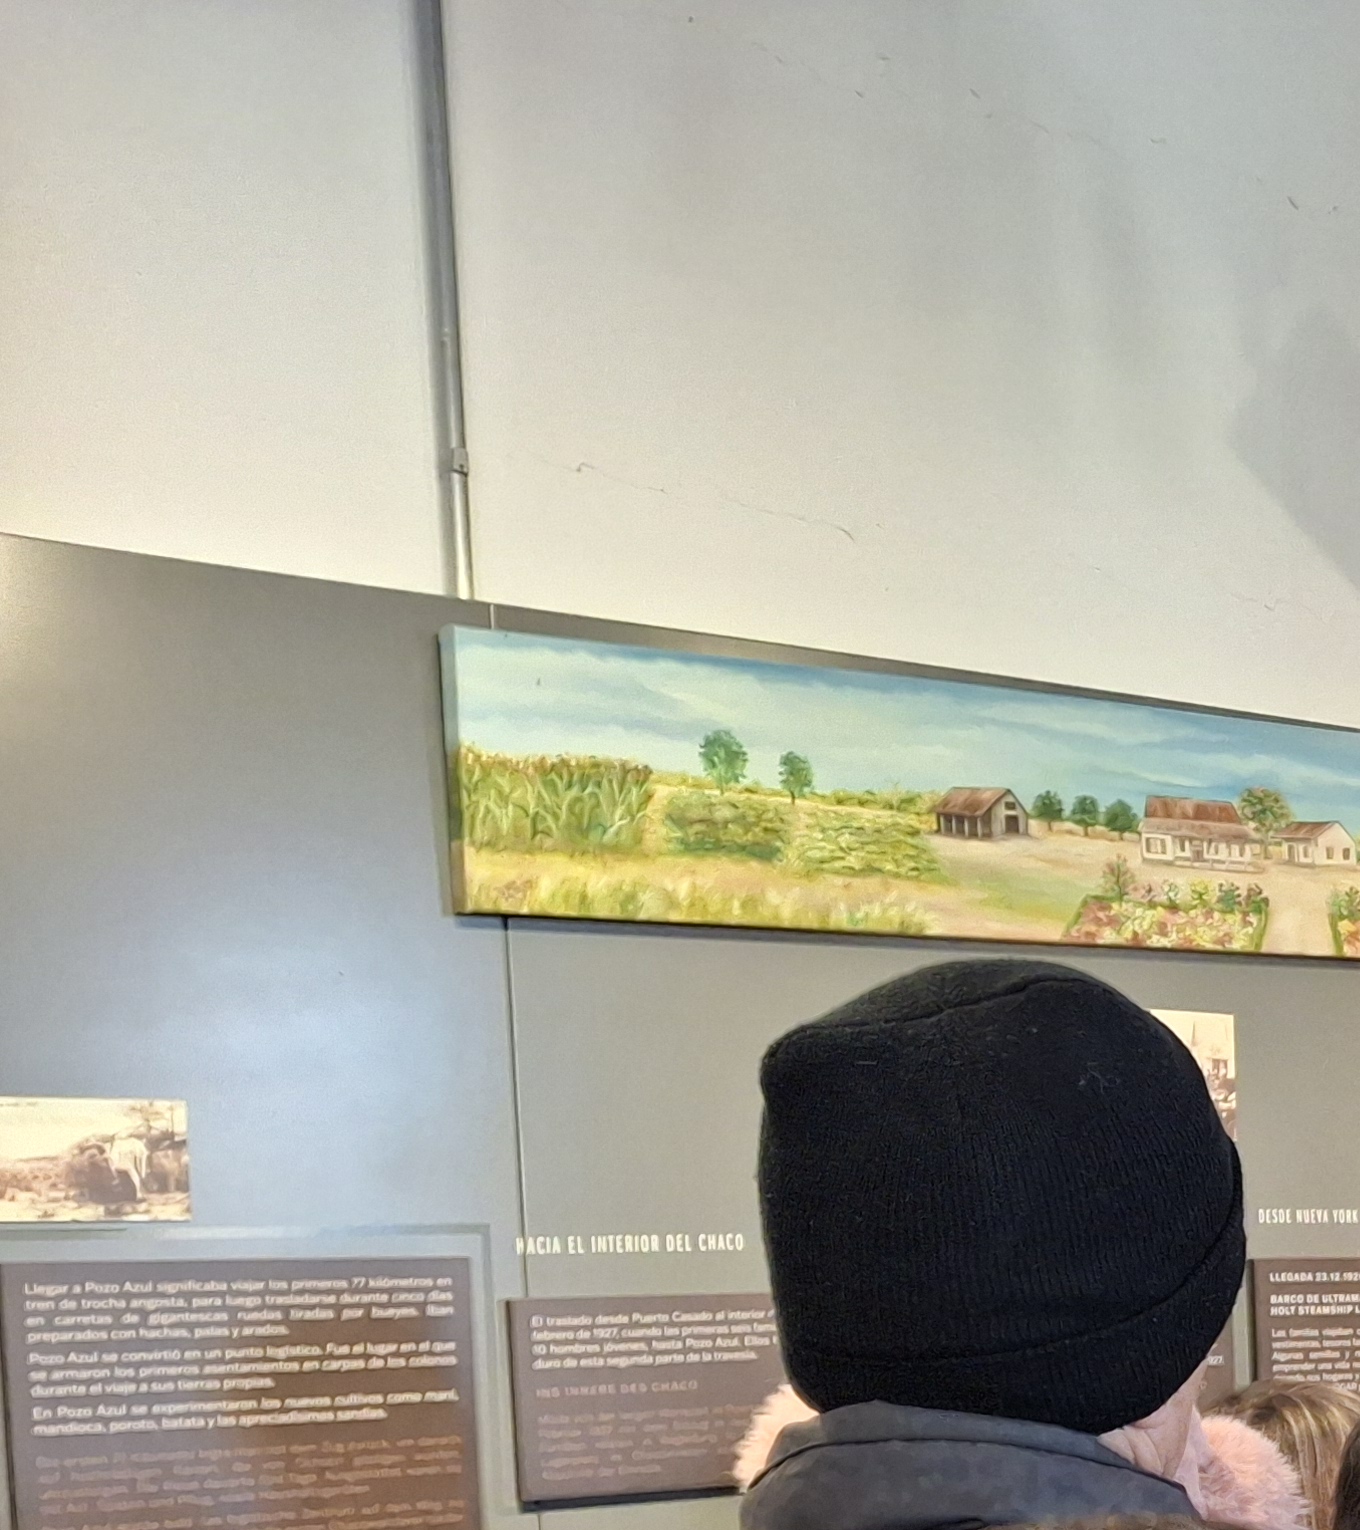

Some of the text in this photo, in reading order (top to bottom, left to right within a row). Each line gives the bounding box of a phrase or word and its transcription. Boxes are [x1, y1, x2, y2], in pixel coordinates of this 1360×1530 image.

[1258, 1208, 1291, 1223] DESDE
[1296, 1208, 1328, 1223] NUEVA
[1332, 1208, 1358, 1223] YORK
[515, 1233, 743, 1255] HACIA EL INTERIOR DEL CHACO
